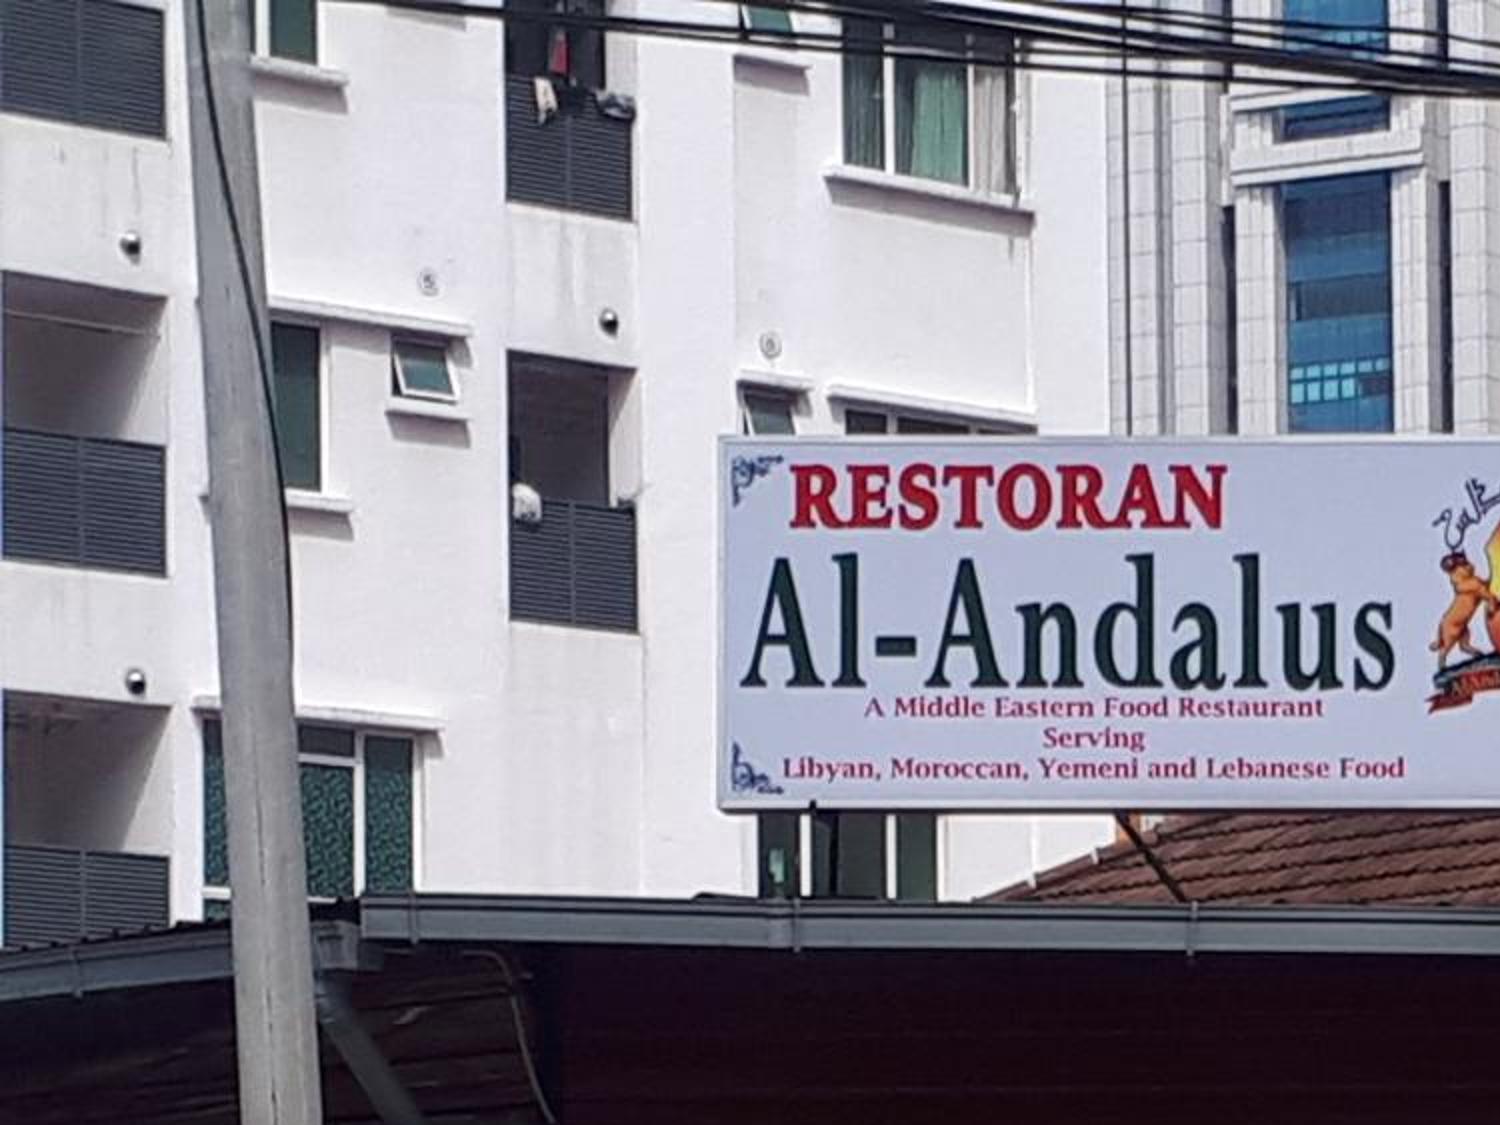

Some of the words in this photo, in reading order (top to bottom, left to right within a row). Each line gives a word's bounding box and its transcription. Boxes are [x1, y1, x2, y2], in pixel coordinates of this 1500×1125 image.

[789, 463, 1227, 531] RESTORAN
[740, 552, 1395, 691] Al-Andalus
[865, 700, 885, 717] A
[896, 697, 985, 718] Middle
[995, 698, 1095, 718] Eastern
[1104, 698, 1168, 718] Food
[1178, 698, 1324, 718] Restaurant
[1043, 727, 1146, 751] Serving
[783, 757, 882, 781] Libyan,
[891, 757, 1029, 781] Moroccan,
[1038, 757, 1139, 779] Yemeni
[1148, 757, 1197, 778] and
[1207, 757, 1329, 779] Lebanese
[1340, 757, 1405, 778] Food
